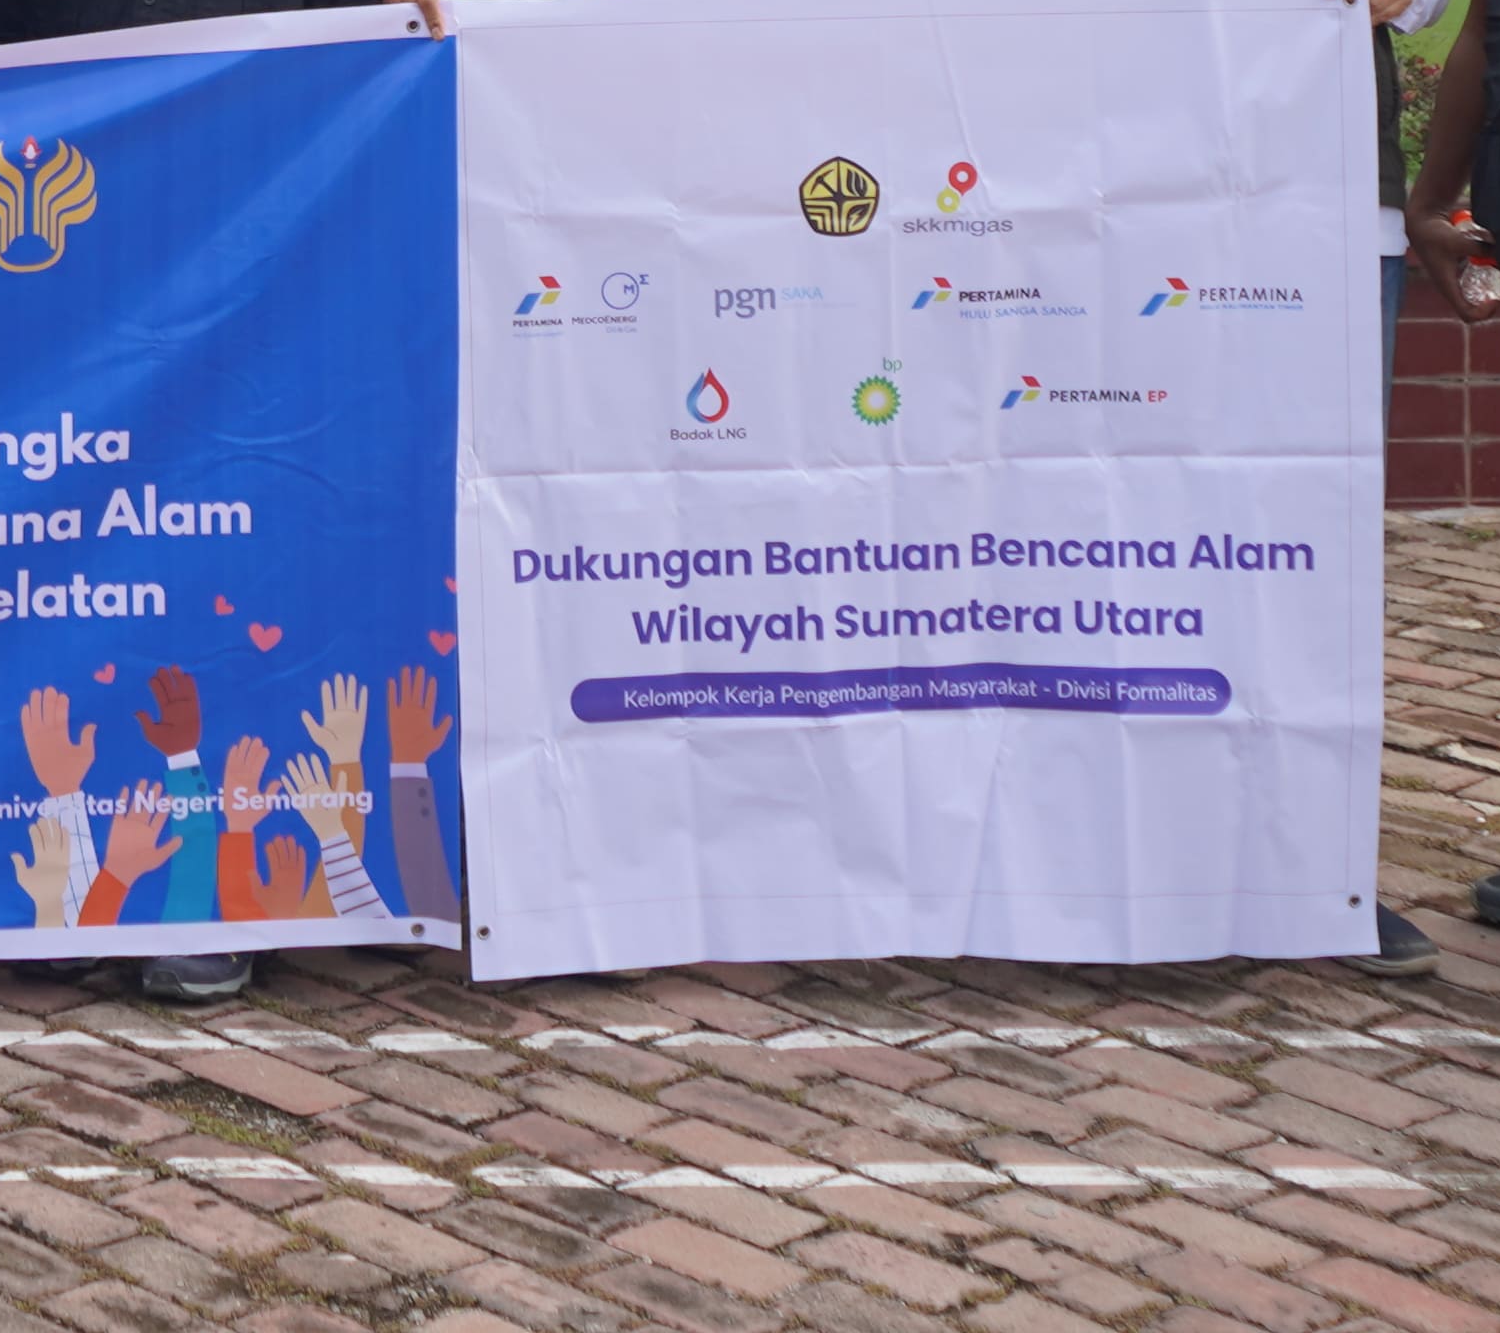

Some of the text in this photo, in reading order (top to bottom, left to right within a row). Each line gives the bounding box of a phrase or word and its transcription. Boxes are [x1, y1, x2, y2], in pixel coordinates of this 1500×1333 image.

[902, 217, 1014, 237] skkmigas
[714, 287, 777, 319] pgn
[959, 288, 1042, 303] PERTAMINA
[1199, 287, 1304, 302] PERTAMINA
[995, 306, 1039, 318] SANGA
[1041, 305, 1088, 317] SANGA
[882, 357, 903, 374] bp
[1049, 389, 1168, 403] PERTAMINA EP
[670, 427, 747, 441] Badak LNG
[96, 484, 252, 537] Alam
[512, 532, 1315, 589] Dukungan Bantuan Bencana Alam
[631, 599, 1204, 654] Wilayah Sumatera Utara
[623, 685, 720, 709] Kelompok
[724, 684, 775, 708] Kerja
[780, 680, 923, 709] Pengembangan
[929, 678, 1037, 703] Masyarakat
[1056, 678, 1111, 700] Divisi
[1116, 680, 1217, 702] Formalitas
[134, 788, 225, 821] Negeri
[232, 786, 374, 813] Semarang
